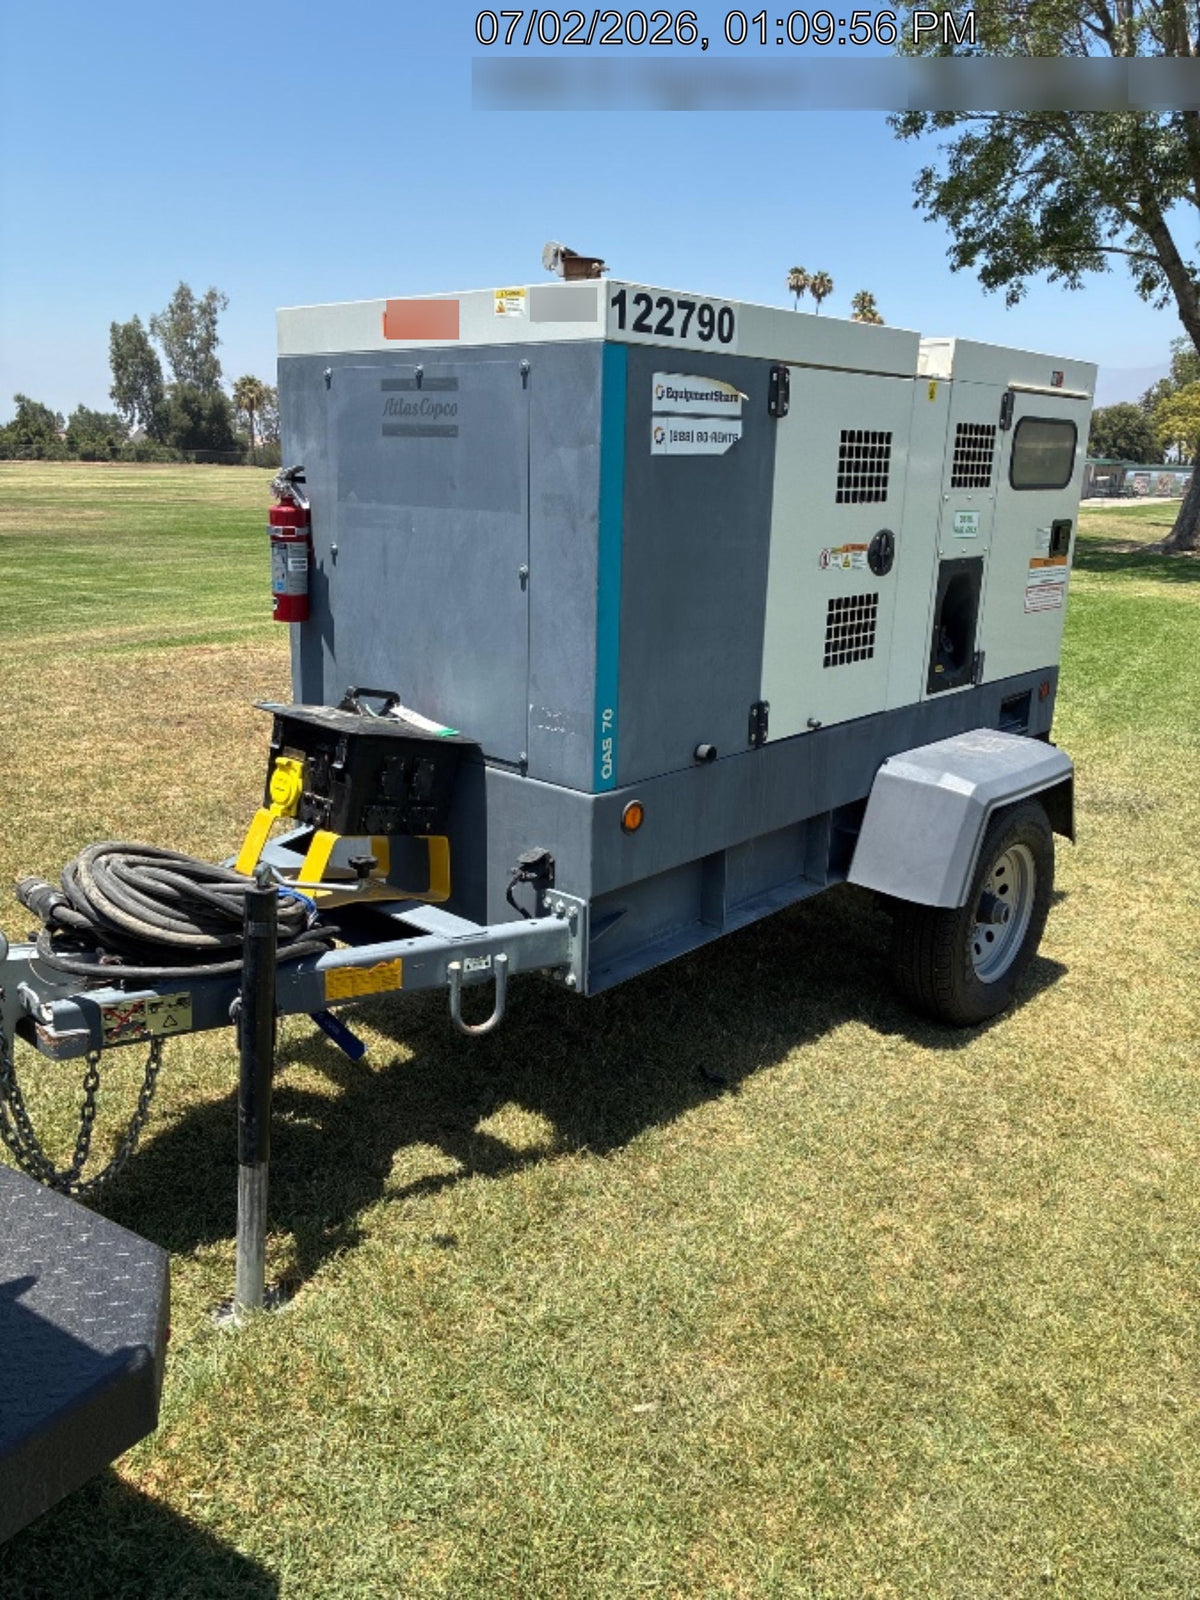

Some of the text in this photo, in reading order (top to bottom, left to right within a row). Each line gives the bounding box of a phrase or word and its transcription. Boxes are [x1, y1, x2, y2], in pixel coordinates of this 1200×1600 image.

[611, 289, 735, 344] 122790
[601, 708, 614, 780] QAS 70
